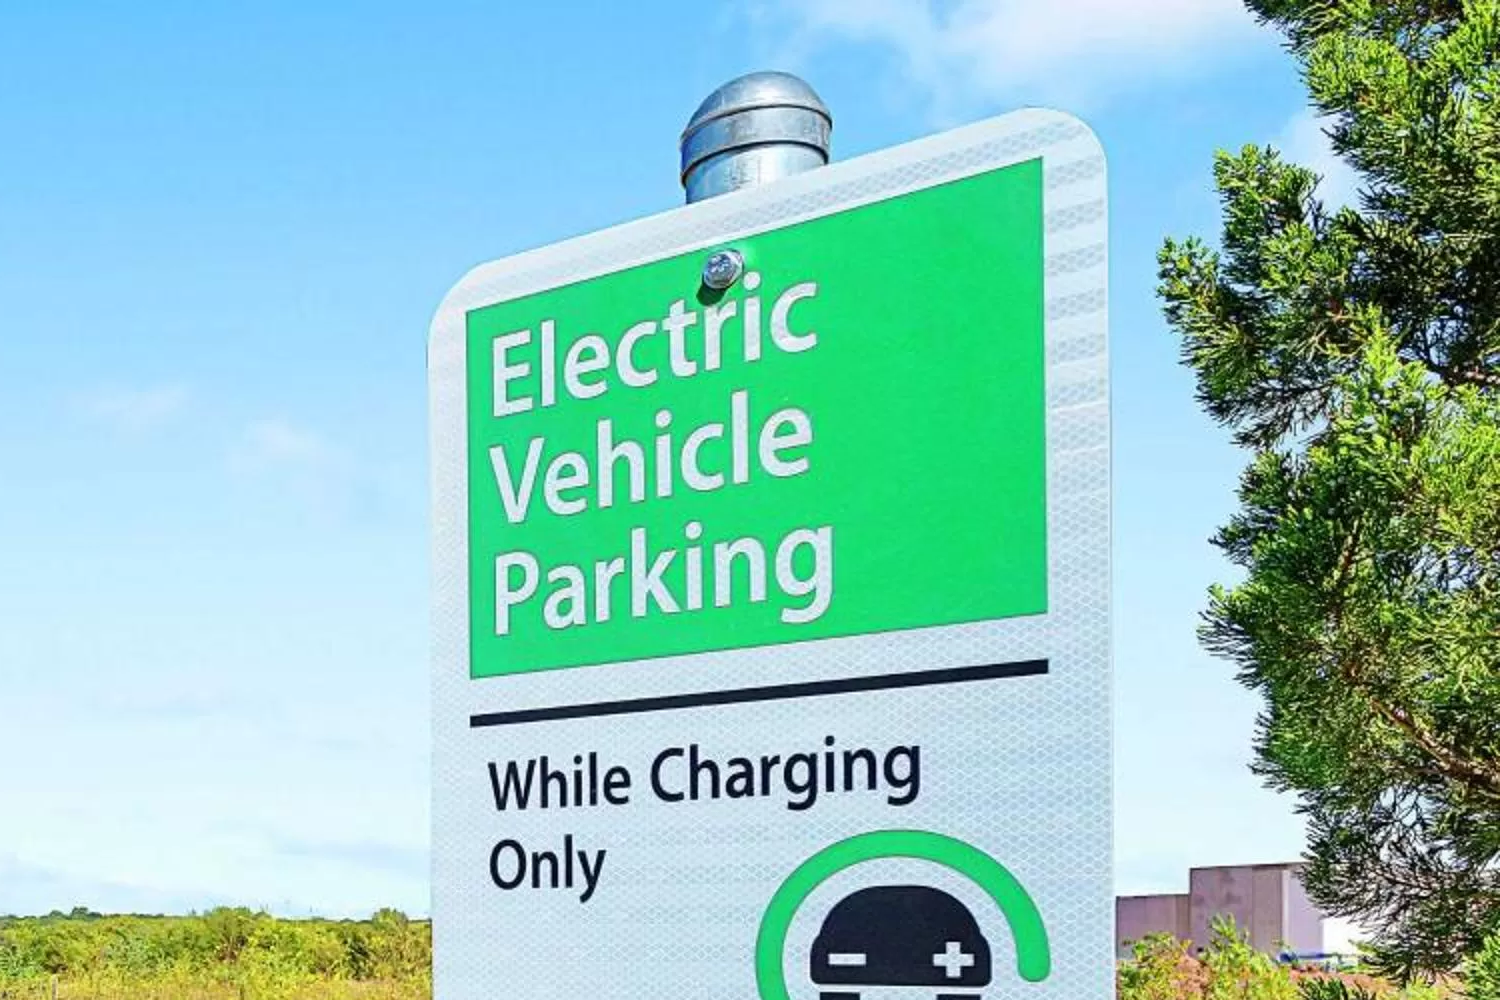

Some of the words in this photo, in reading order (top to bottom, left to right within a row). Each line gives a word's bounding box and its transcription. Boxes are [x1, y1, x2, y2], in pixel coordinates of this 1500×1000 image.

[491, 270, 819, 418] Electric
[488, 389, 813, 524] Vehicle
[494, 522, 834, 636] Parking
[488, 752, 631, 811] While
[649, 735, 921, 811] Charging
[488, 834, 606, 902] Only
